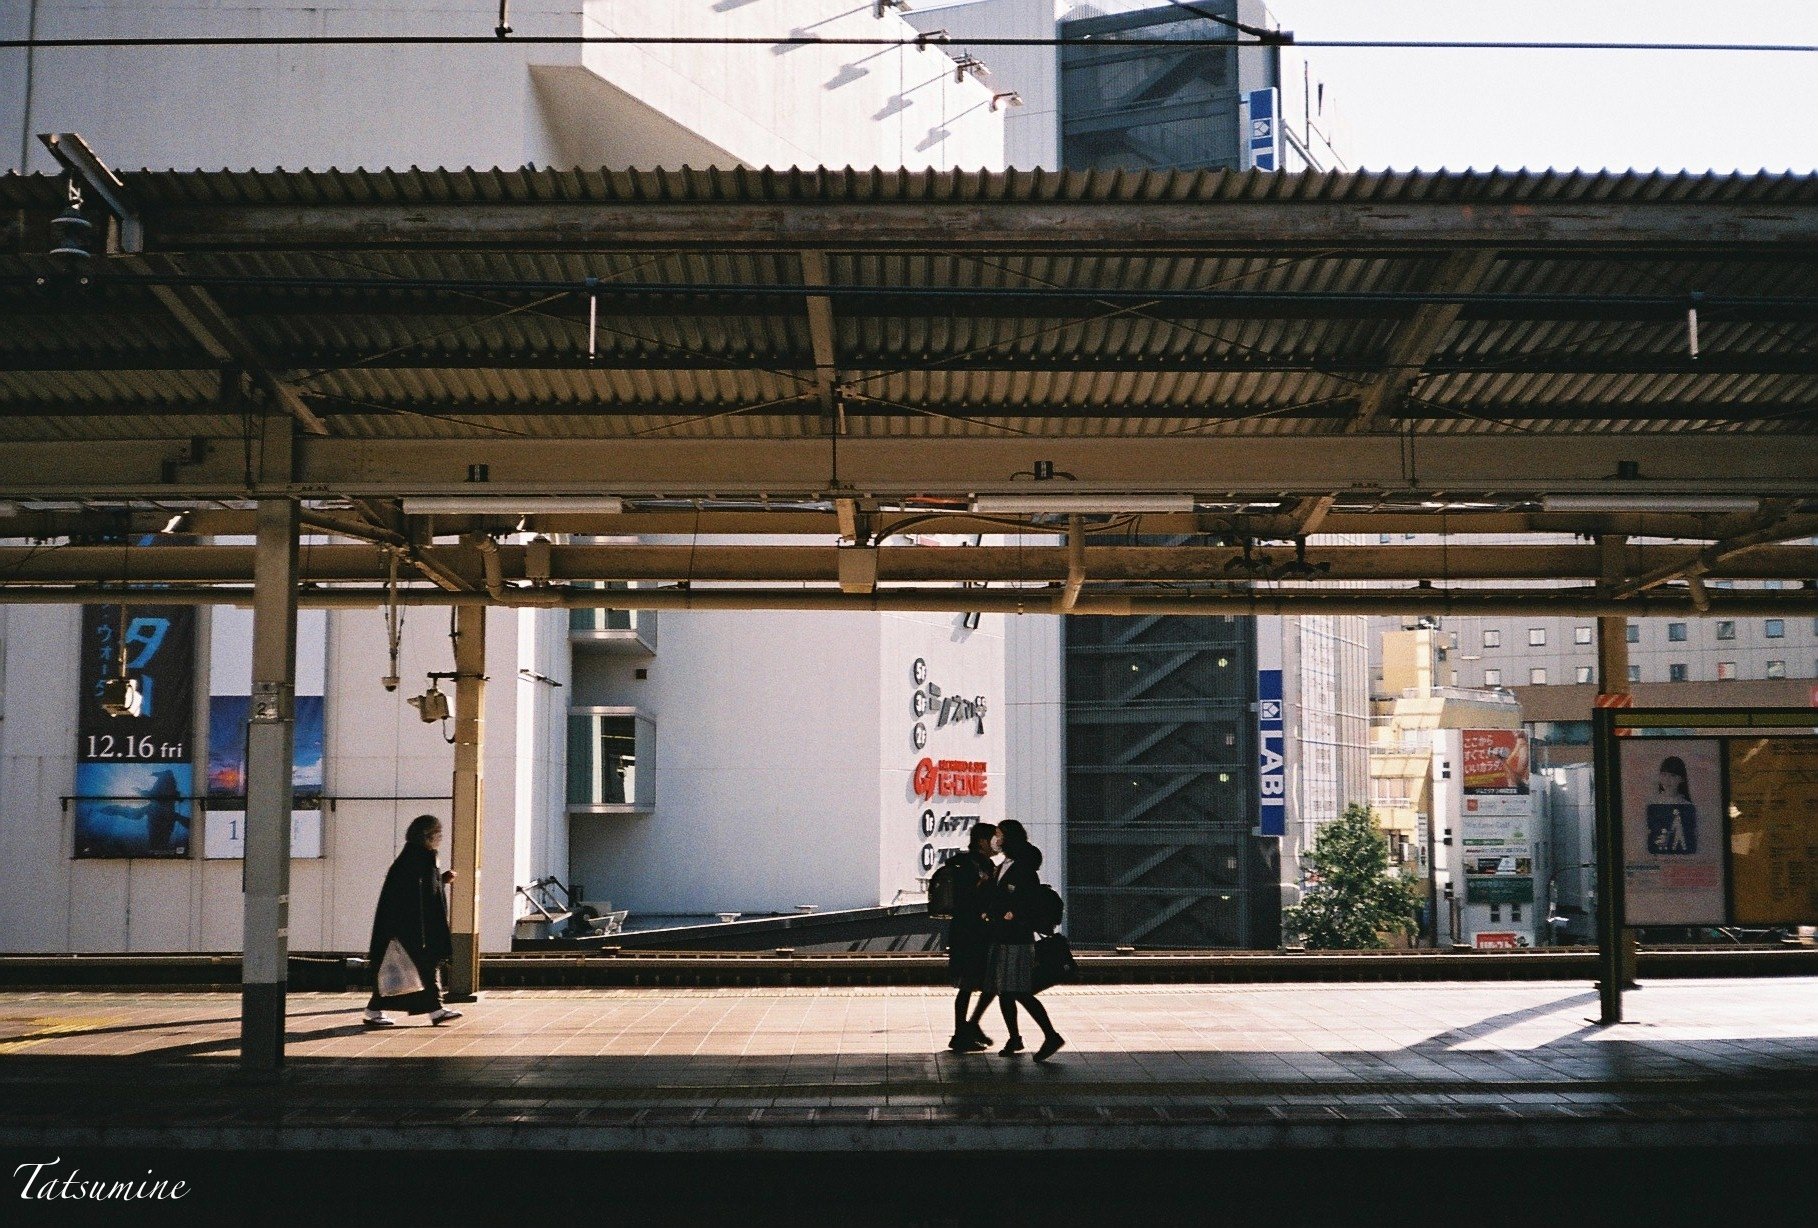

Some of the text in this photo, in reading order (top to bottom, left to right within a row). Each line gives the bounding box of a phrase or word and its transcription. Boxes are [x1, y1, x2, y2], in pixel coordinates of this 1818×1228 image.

[87, 735, 184, 759] 12.16 fri
[1260, 730, 1284, 806] LABI
